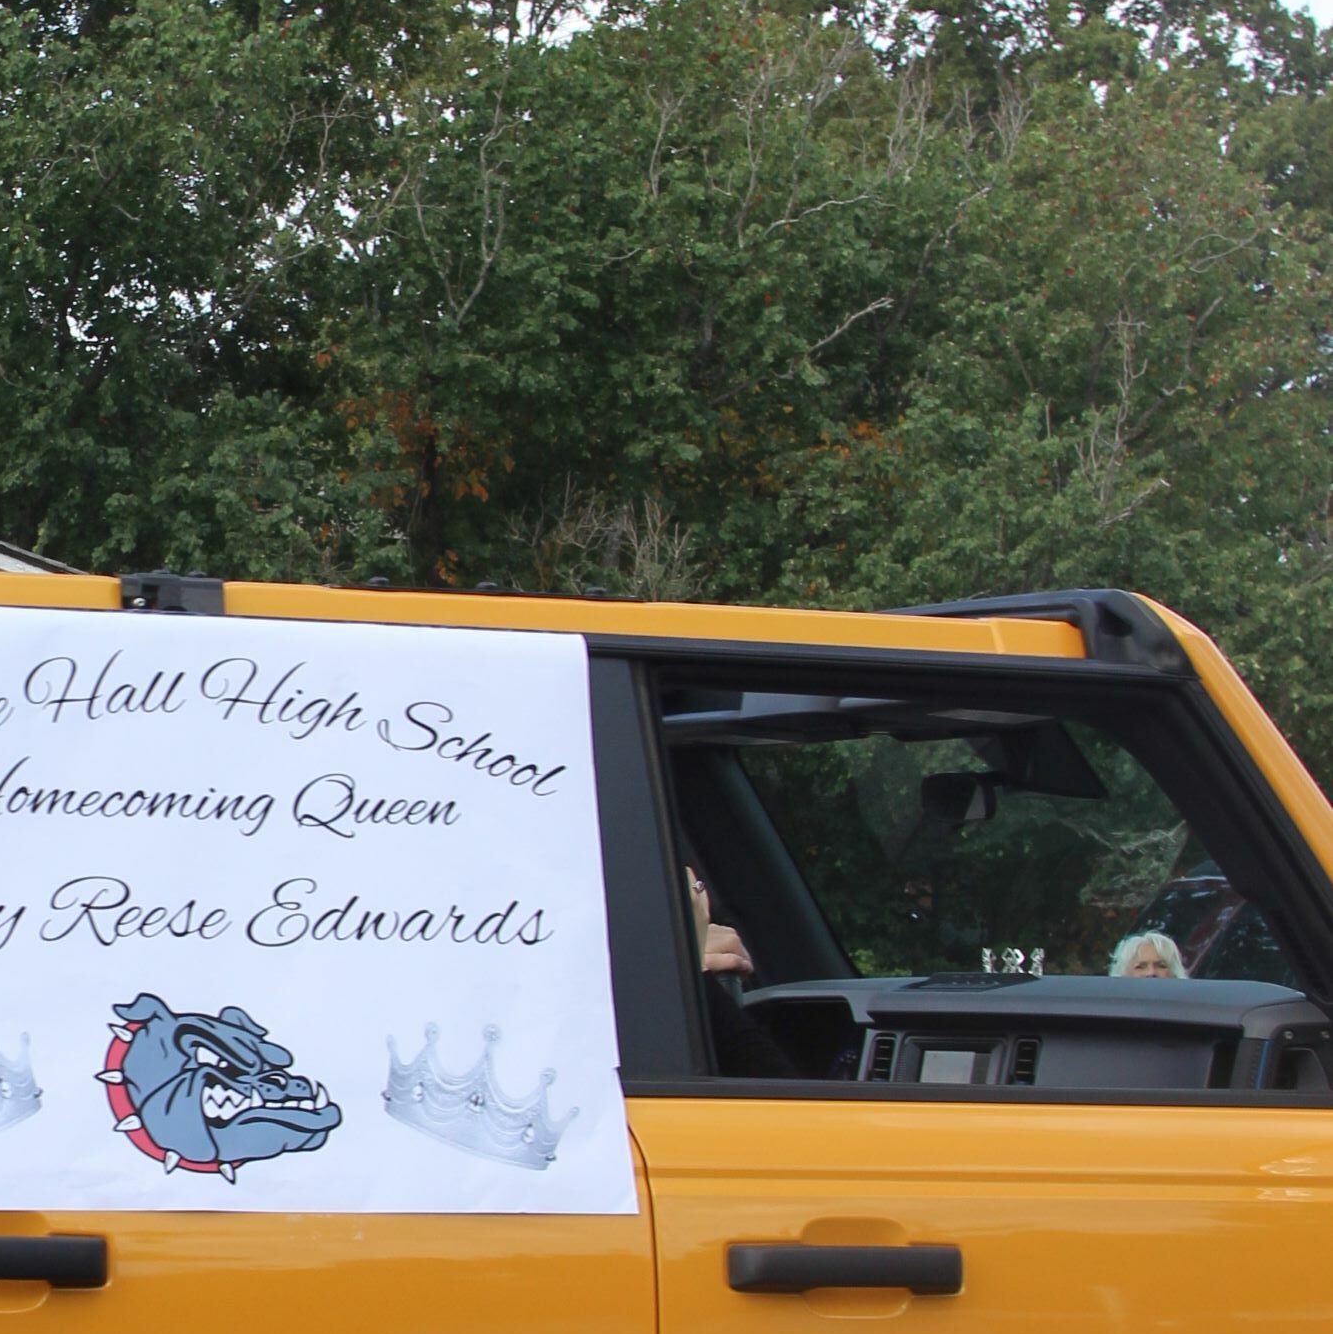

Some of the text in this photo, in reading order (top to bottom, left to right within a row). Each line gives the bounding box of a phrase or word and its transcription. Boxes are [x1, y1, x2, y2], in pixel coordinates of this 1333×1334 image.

[22, 649, 187, 724] Hall
[200, 657, 368, 741] High
[377, 701, 568, 797] School
[292, 772, 462, 840] Queen
[39, 875, 233, 948] Reese
[245, 877, 555, 948] Edwards
